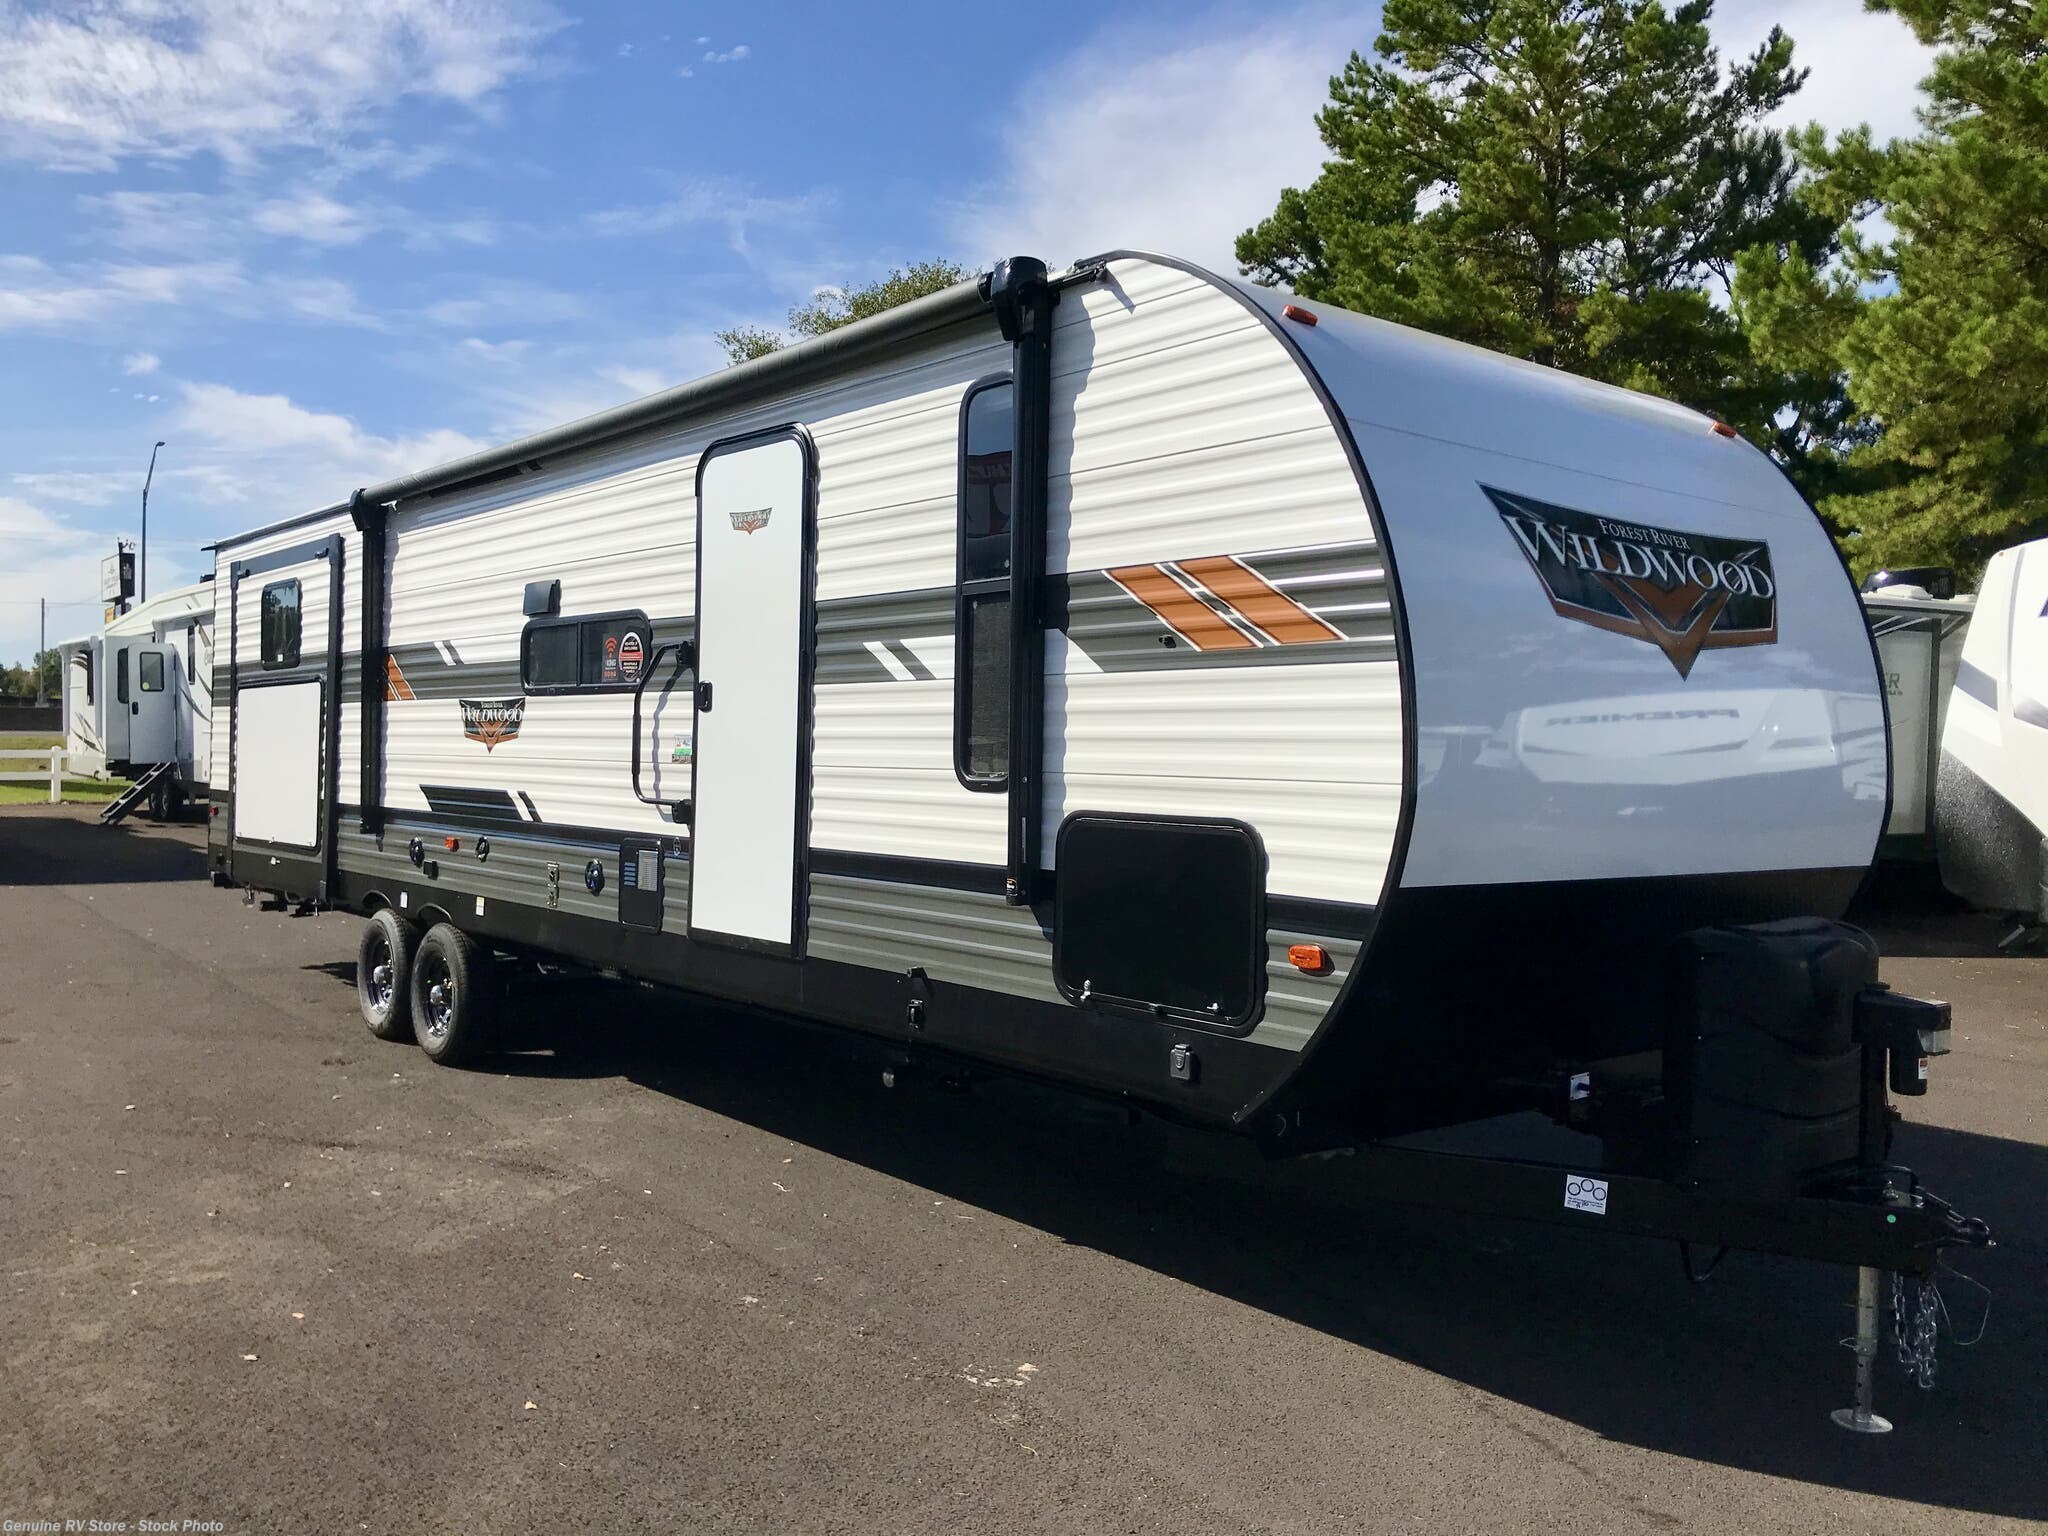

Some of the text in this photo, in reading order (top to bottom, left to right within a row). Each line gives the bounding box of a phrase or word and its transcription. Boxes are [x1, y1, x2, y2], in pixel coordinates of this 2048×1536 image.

[1598, 518, 1690, 550] FOREST RIVER
[1502, 514, 1774, 598] WILDWOOD
[462, 707, 523, 722] WILDWOOD
